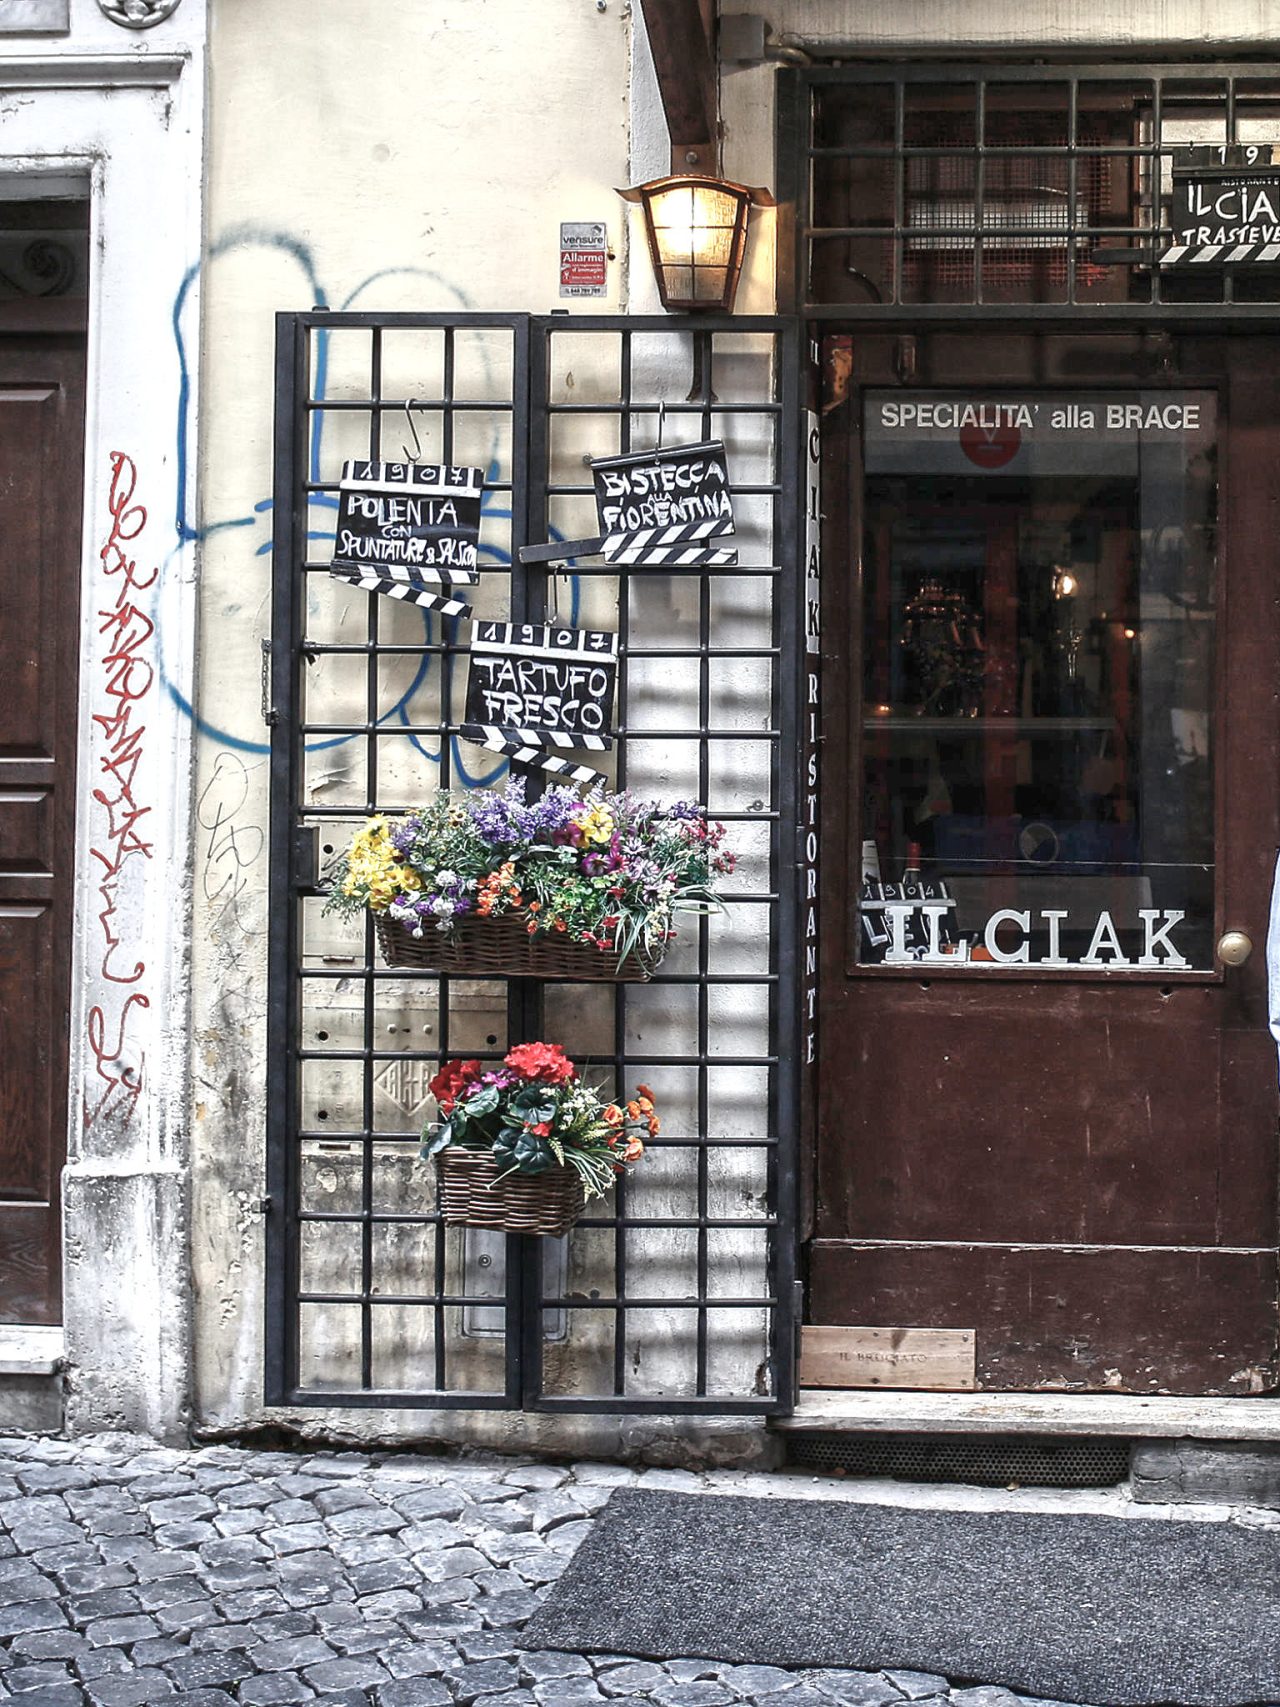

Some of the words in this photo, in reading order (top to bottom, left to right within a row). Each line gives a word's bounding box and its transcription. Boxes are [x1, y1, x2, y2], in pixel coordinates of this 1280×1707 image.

[563, 253, 604, 262] Allarme
[1050, 405, 1095, 429] alla
[1106, 404, 1200, 430] BRACE
[601, 460, 726, 496] BISTECCA
[347, 494, 458, 528] POLENTA
[602, 490, 732, 534] FIORENTINA
[648, 491, 673, 505] ALLA
[381, 525, 412, 538] CON
[808, 428, 821, 637] CIAK
[473, 657, 608, 699] TARTUFO
[482, 689, 604, 730] FRESCO
[806, 673, 818, 1065] RISTORANTE
[884, 904, 967, 962] IL
[984, 909, 1187, 965] CIAK
[839, 1352, 851, 1361] IL
[857, 1353, 927, 1363] BRUCIATO
